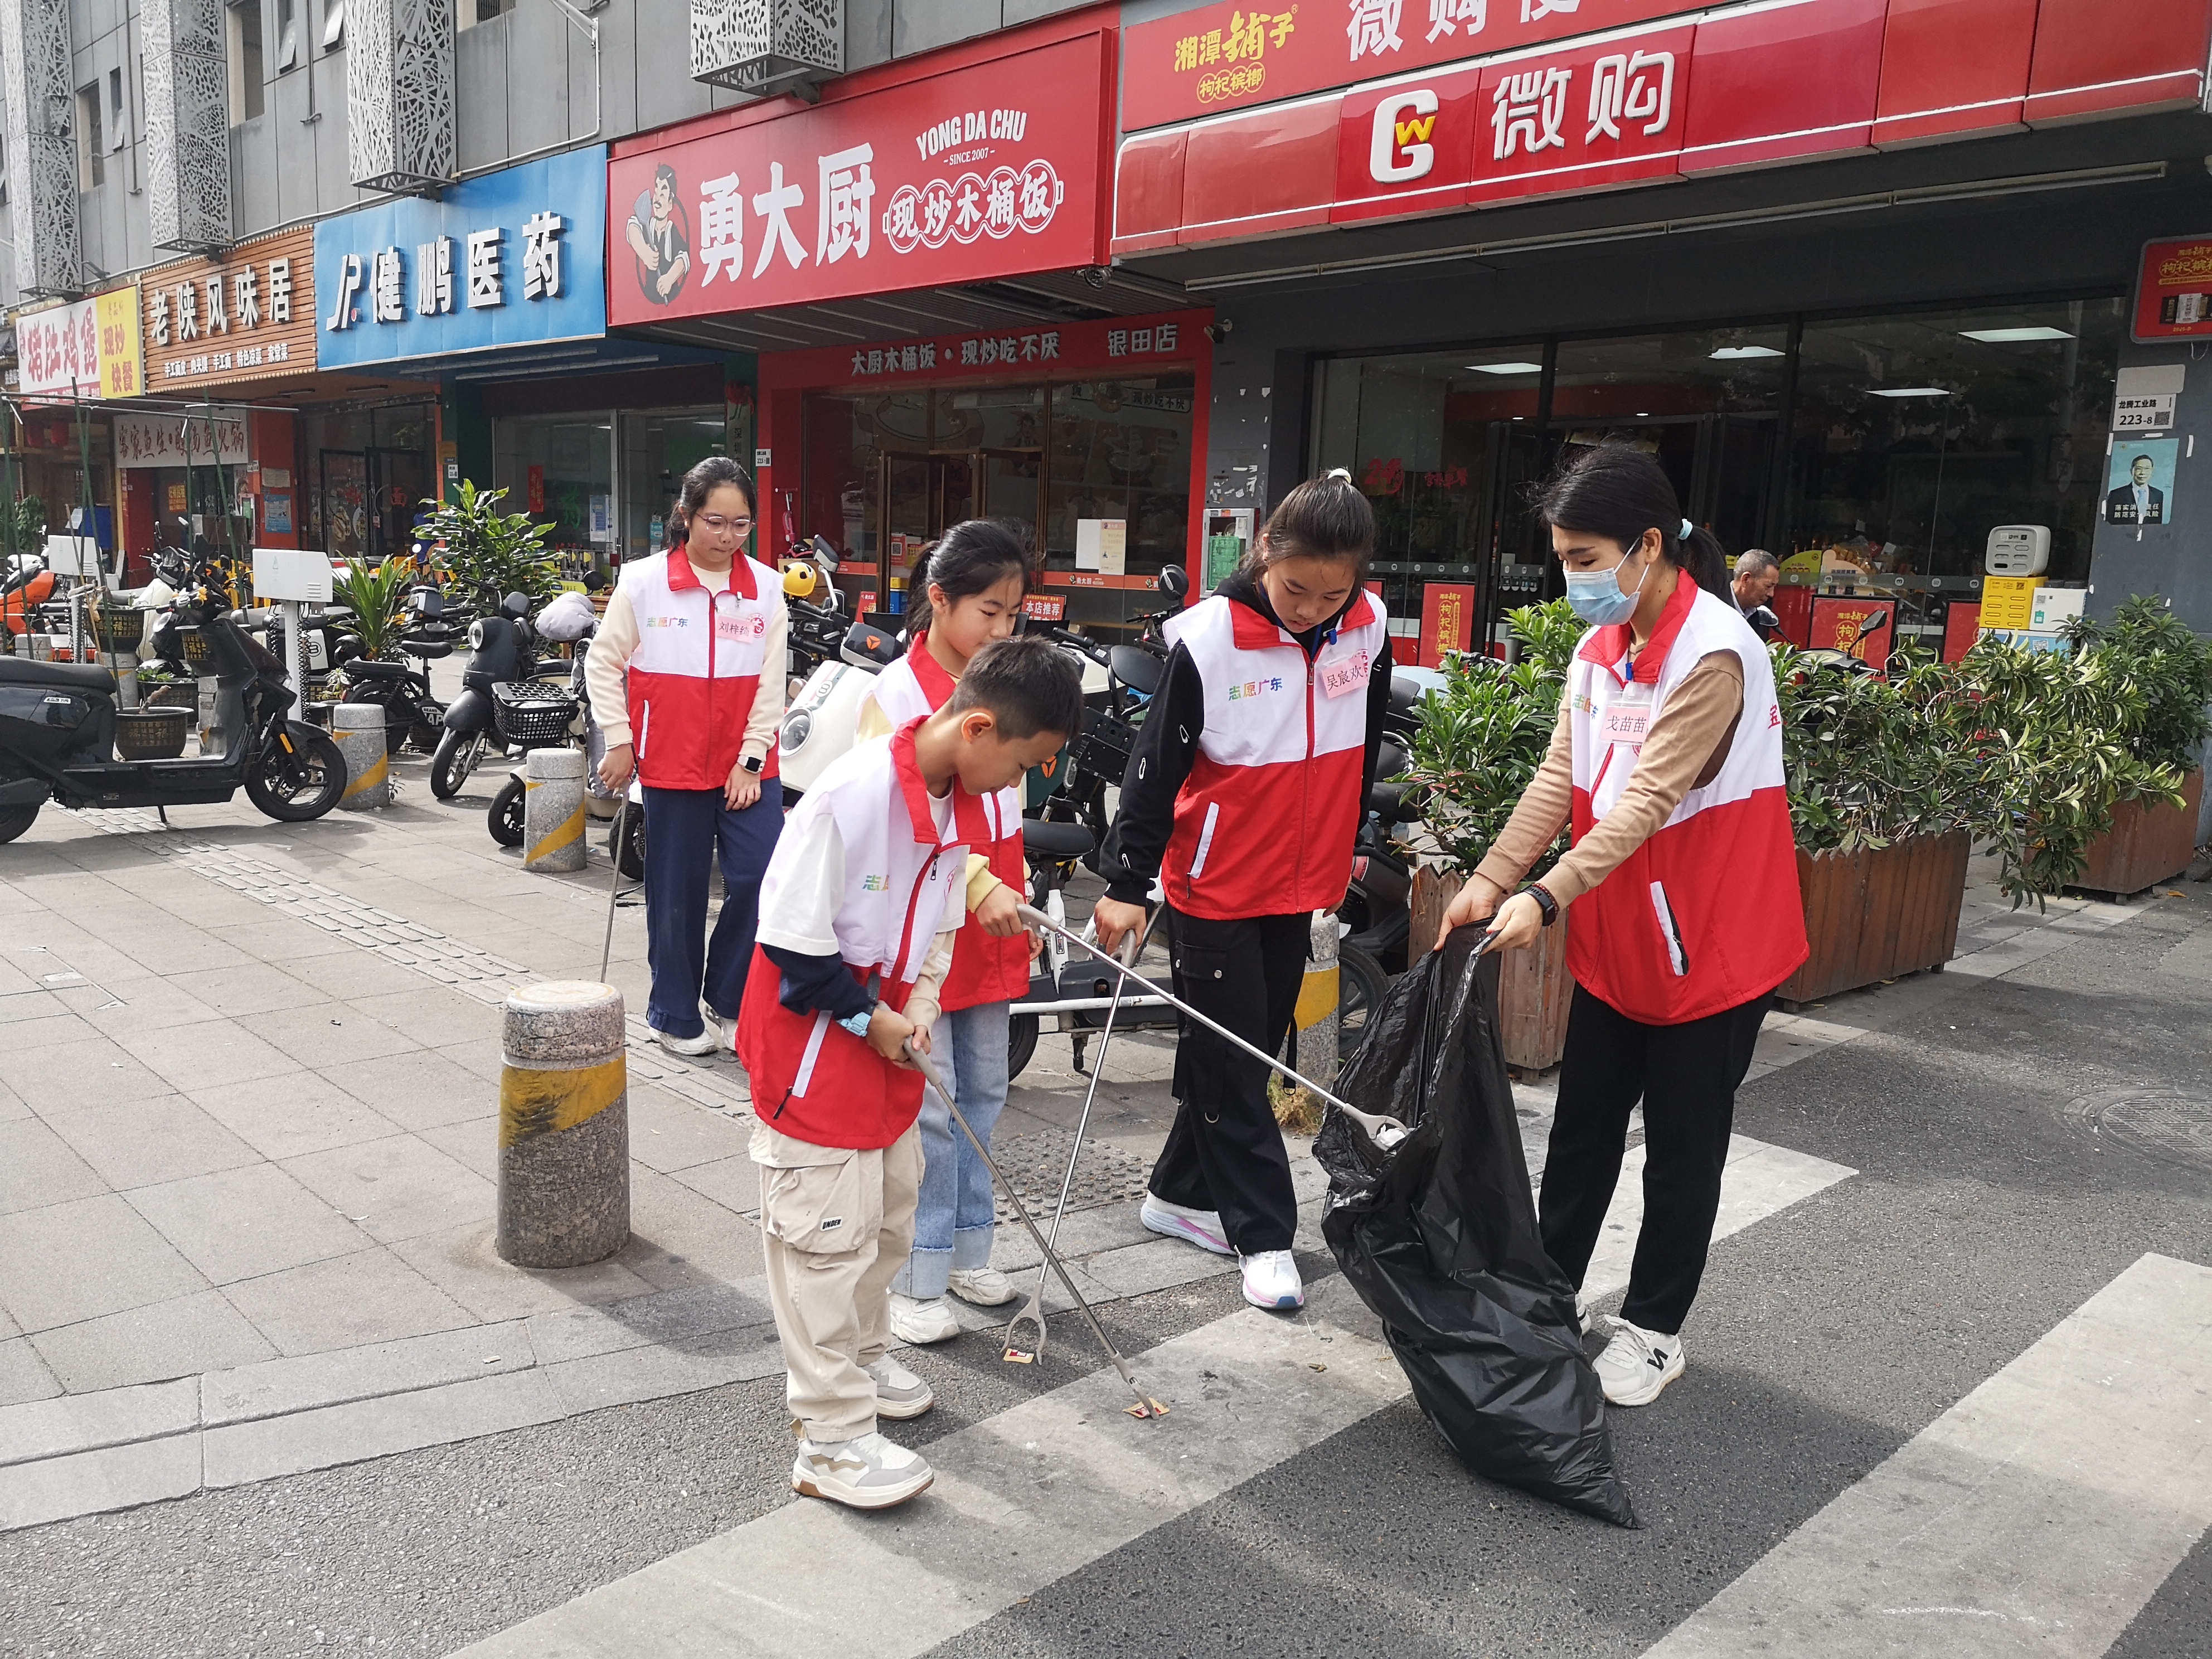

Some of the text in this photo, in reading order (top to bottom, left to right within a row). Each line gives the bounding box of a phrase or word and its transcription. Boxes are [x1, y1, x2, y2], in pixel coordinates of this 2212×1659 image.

[1199, 67, 1264, 98] 枸杞槟榔
[1492, 50, 1675, 161] 微购
[916, 109, 1027, 162] YONG DA CHU
[949, 147, 989, 166] SINCE 2007
[700, 142, 876, 288] 勇大厨
[892, 171, 1051, 237] 现炒木桶饭
[369, 210, 567, 325] 健鹏医药
[151, 257, 293, 346] 老陕风味居
[1108, 323, 1178, 357] 银田店
[2118, 399, 2156, 409] 龙腾工业路
[2119, 414, 2152, 425] 223-8
[1026, 600, 1060, 616] 本店推荐
[647, 617, 688, 628] 志愿广东
[1229, 677, 1283, 701] 志愿广东
[1327, 666, 1364, 691] 吴宸欢
[1606, 716, 1646, 733] 戈苗苗
